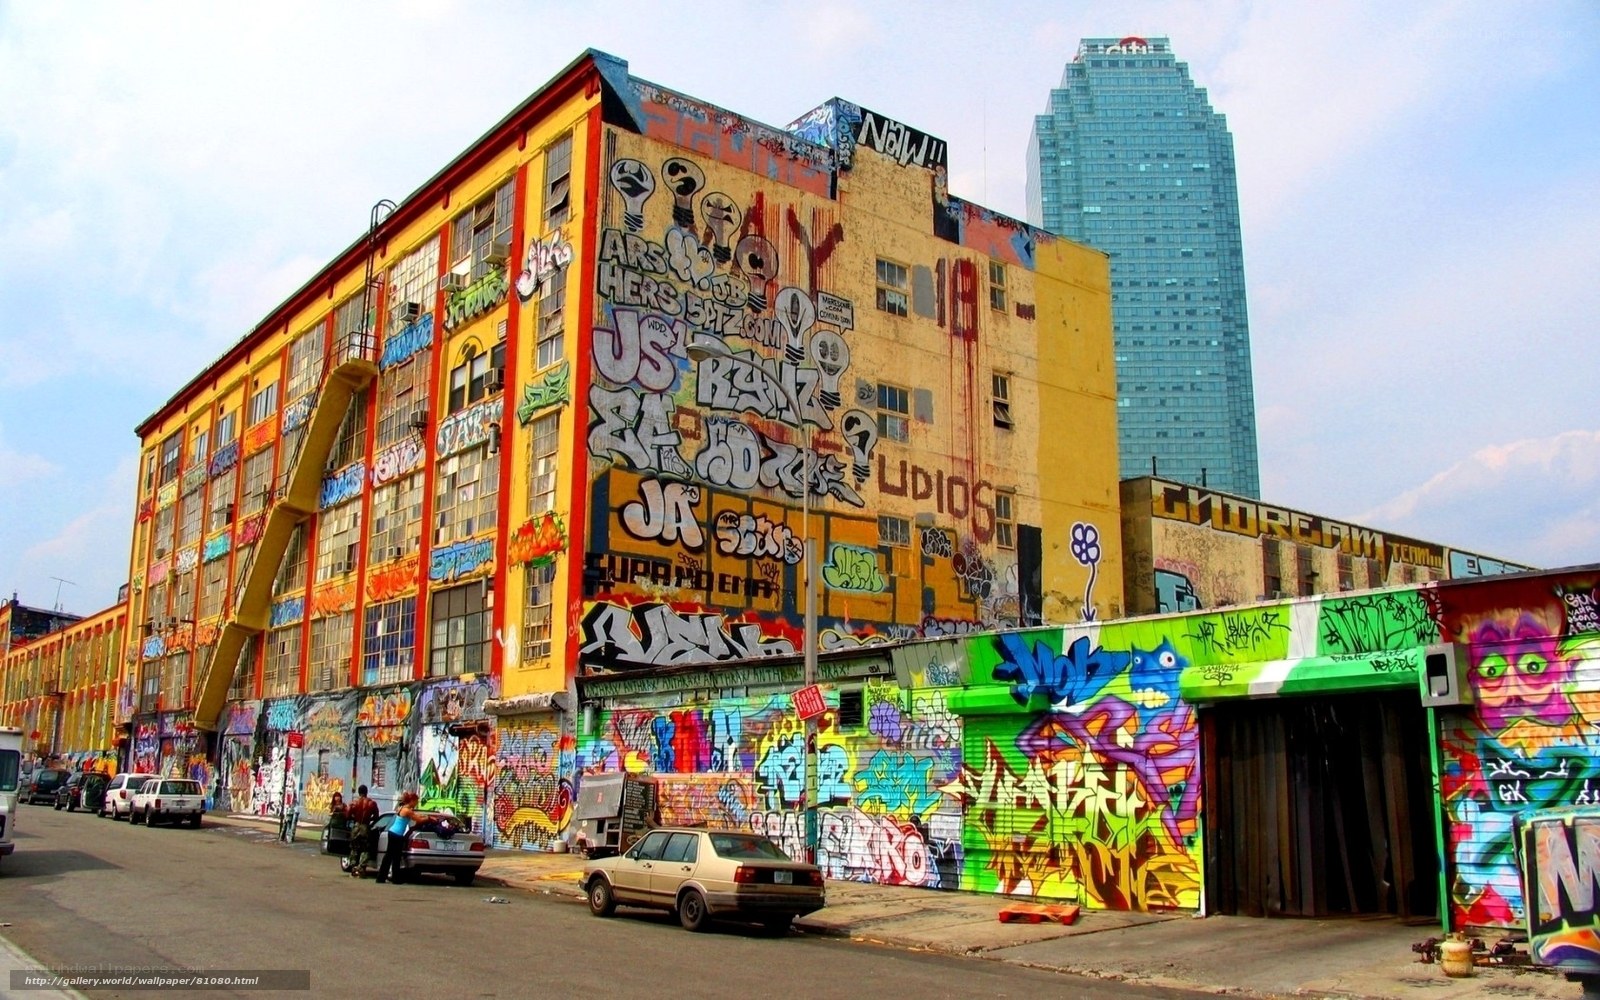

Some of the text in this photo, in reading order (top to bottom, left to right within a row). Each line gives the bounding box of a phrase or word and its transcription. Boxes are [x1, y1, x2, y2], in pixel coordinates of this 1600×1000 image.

[599, 228, 667, 274] ARS
[598, 264, 682, 315] HERS
[621, 479, 704, 549] JA
